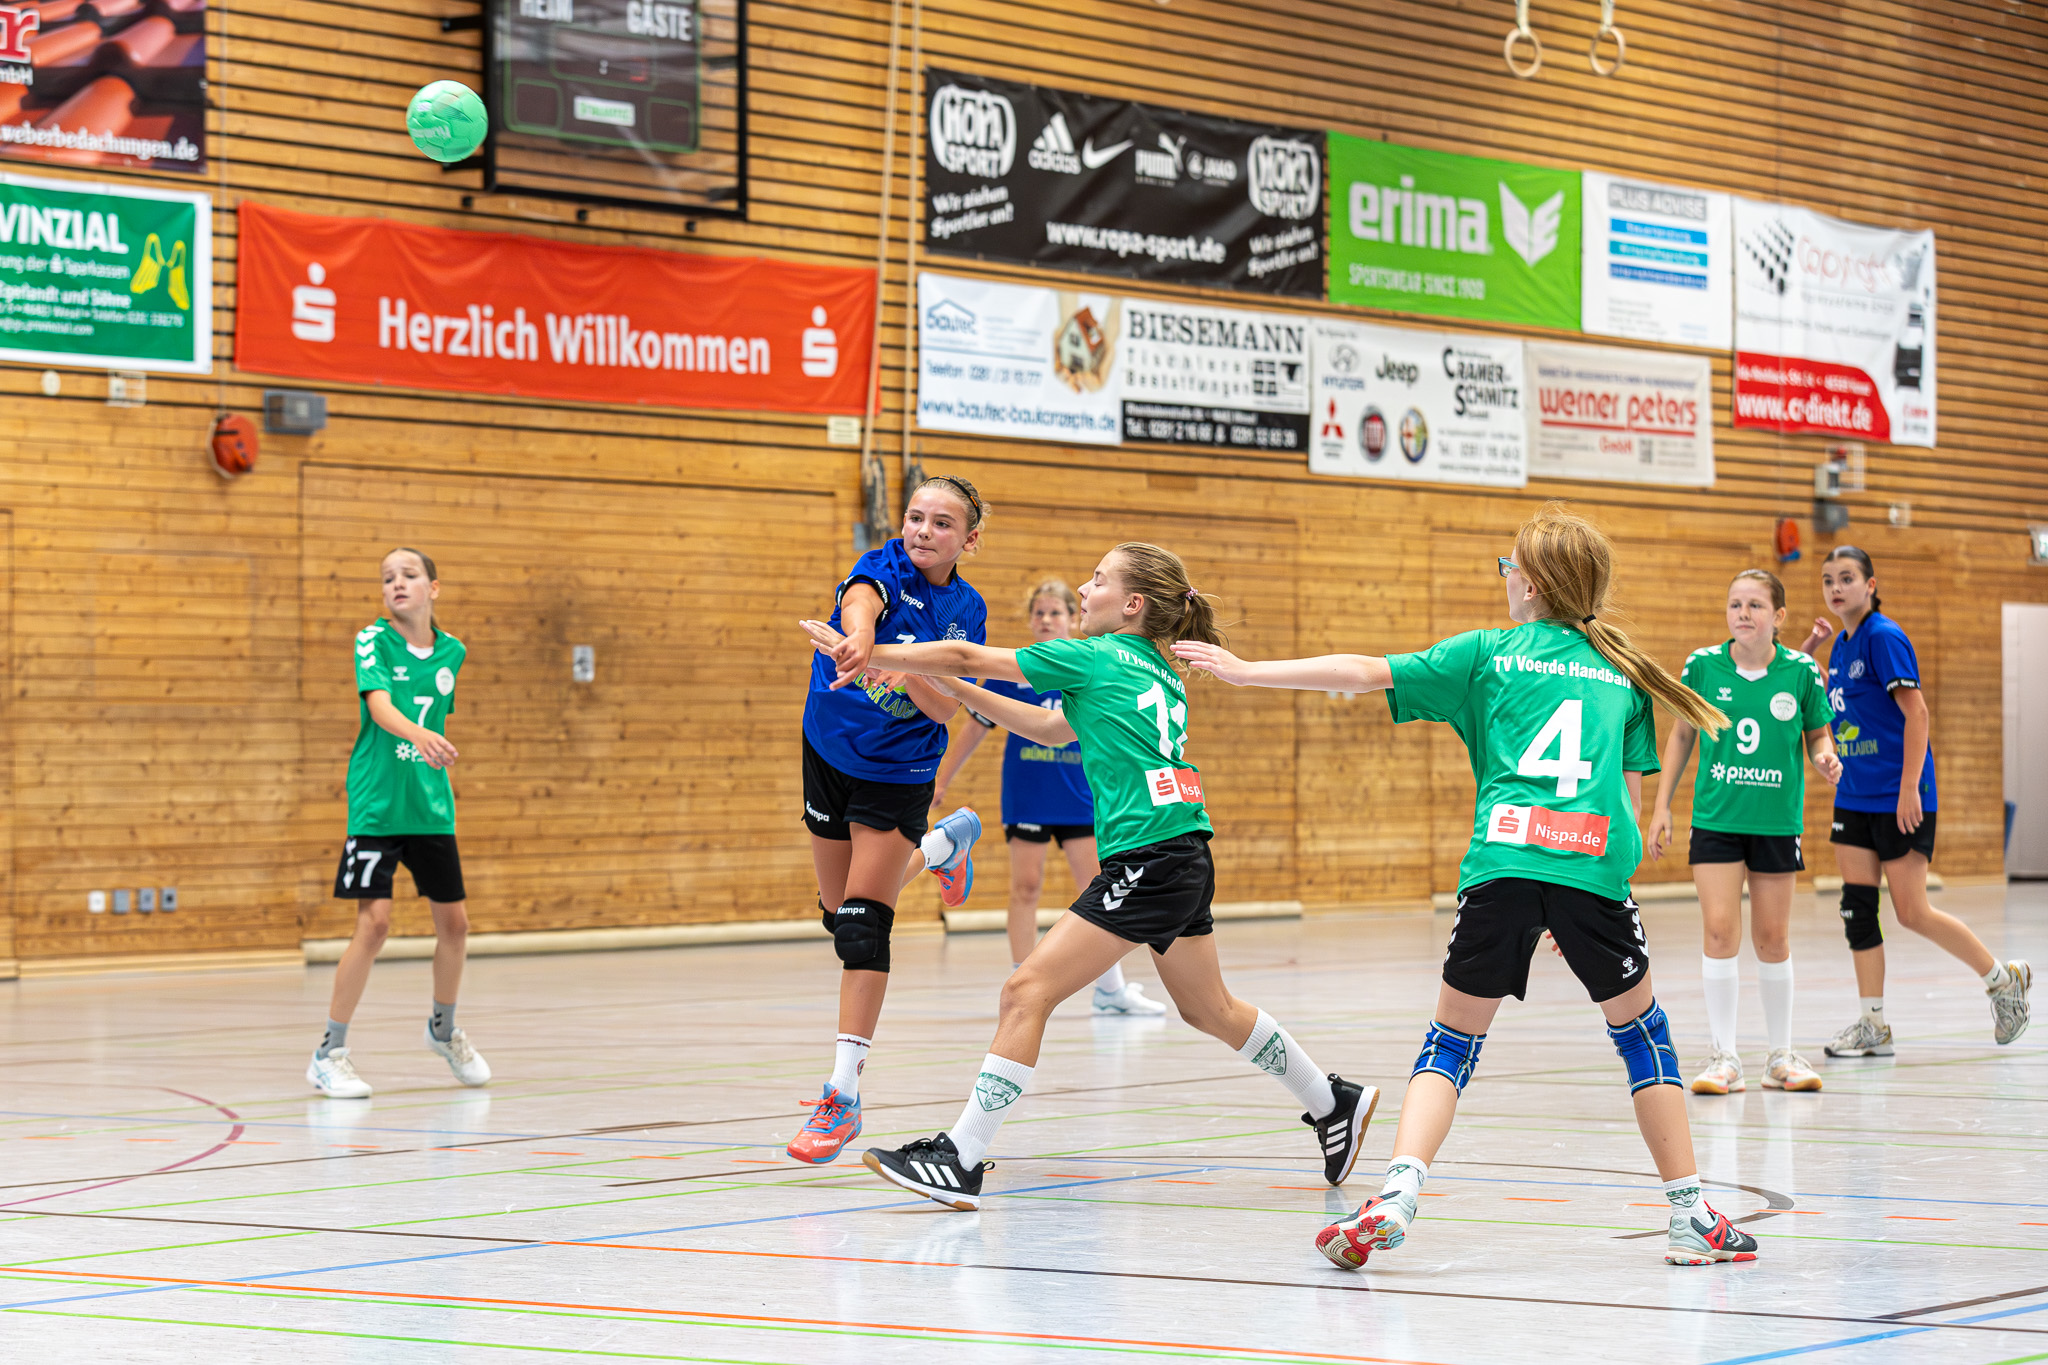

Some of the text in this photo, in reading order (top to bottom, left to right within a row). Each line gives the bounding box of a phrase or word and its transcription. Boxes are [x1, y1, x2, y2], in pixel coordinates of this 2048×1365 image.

[626, 1, 694, 41] GÄSTE
[946, 144, 1002, 179] SPORT
[1349, 175, 1490, 255] erima
[1045, 221, 1227, 264] www.ropa-sport.de
[1349, 262, 1422, 294] SPORTSWEAR
[1424, 272, 1457, 299] SINCE
[379, 296, 539, 361] Herzlich
[545, 313, 771, 376] Willkommen
[1129, 310, 1305, 355] BIESEMANN
[1375, 353, 1419, 388] Jeep
[1455, 384, 1519, 417] SCHMITZ
[1539, 386, 1697, 430] werner peters
[1115, 648, 1131, 663] TV
[1130, 652, 1161, 677] Voerde
[1493, 655, 1512, 673] TV
[1515, 655, 1566, 677] Voerde
[413, 695, 435, 727] 7
[1829, 687, 1846, 713] 16
[1517, 698, 1593, 798] 4
[1736, 717, 1761, 755] 9
[1726, 765, 1783, 785] pixum
[1534, 823, 1601, 847] Nispa.de
[356, 850, 383, 888] 7
[836, 905, 866, 916] Kempa
[812, 1137, 840, 1149] Kempa
